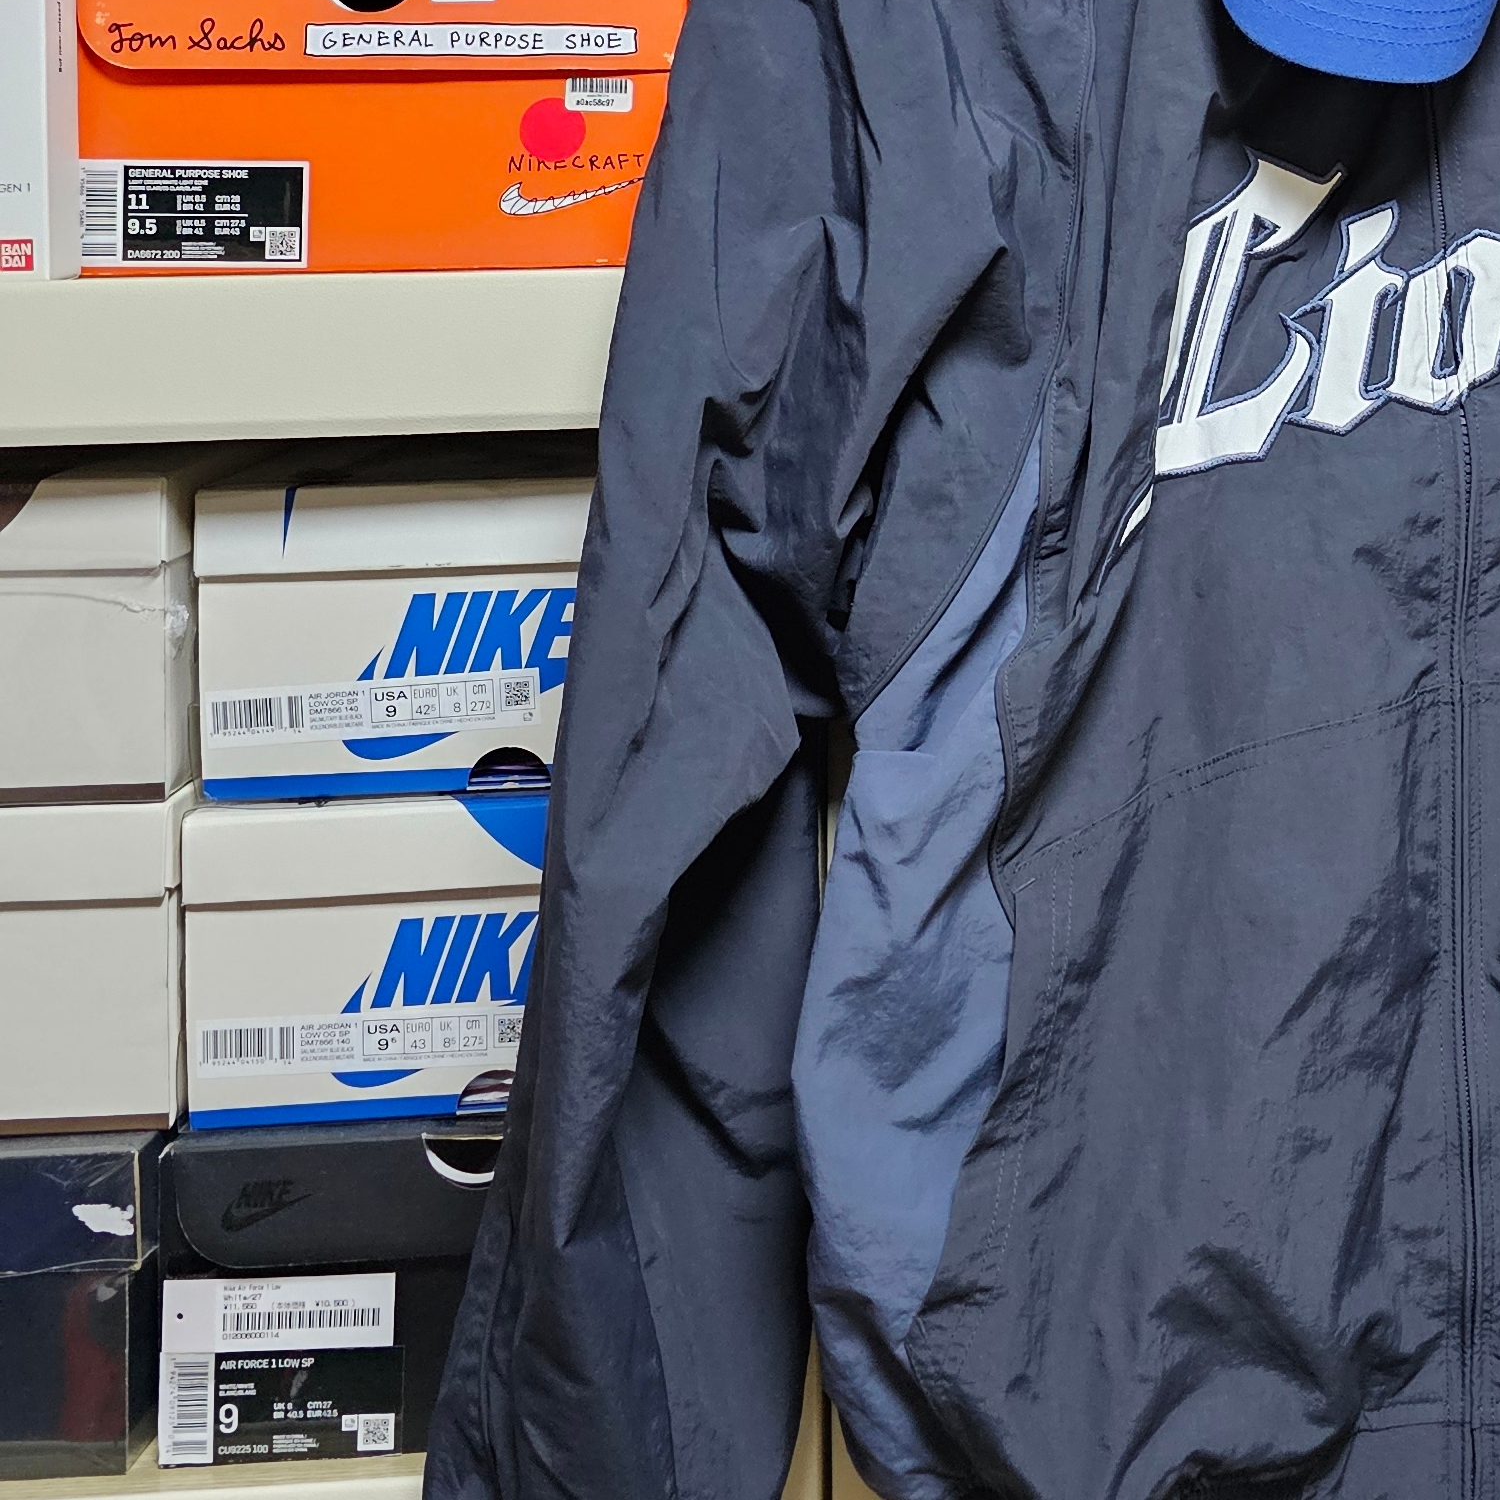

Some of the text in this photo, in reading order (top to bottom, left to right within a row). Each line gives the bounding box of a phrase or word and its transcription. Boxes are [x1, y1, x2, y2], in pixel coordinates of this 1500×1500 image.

[108, 18, 287, 55] Tom Sachs
[321, 29, 623, 50] GENERAL PURPOSE SHOE
[128, 169, 249, 179] GENERAL PURPOSE SHOE
[127, 194, 149, 210] 11
[127, 219, 157, 235] 9.5
[383, 588, 576, 679] NIKE
[325, 690, 357, 700] JORDAN
[374, 686, 459, 702] USA EURO UK
[385, 701, 461, 718] 9 8
[369, 911, 539, 1009] NIK
[366, 1021, 453, 1035] USA EURO UK
[411, 1038, 426, 1050] 43
[220, 1358, 314, 1370] AIR FORCE 1 LOW SP
[219, 1403, 238, 1433] 9
